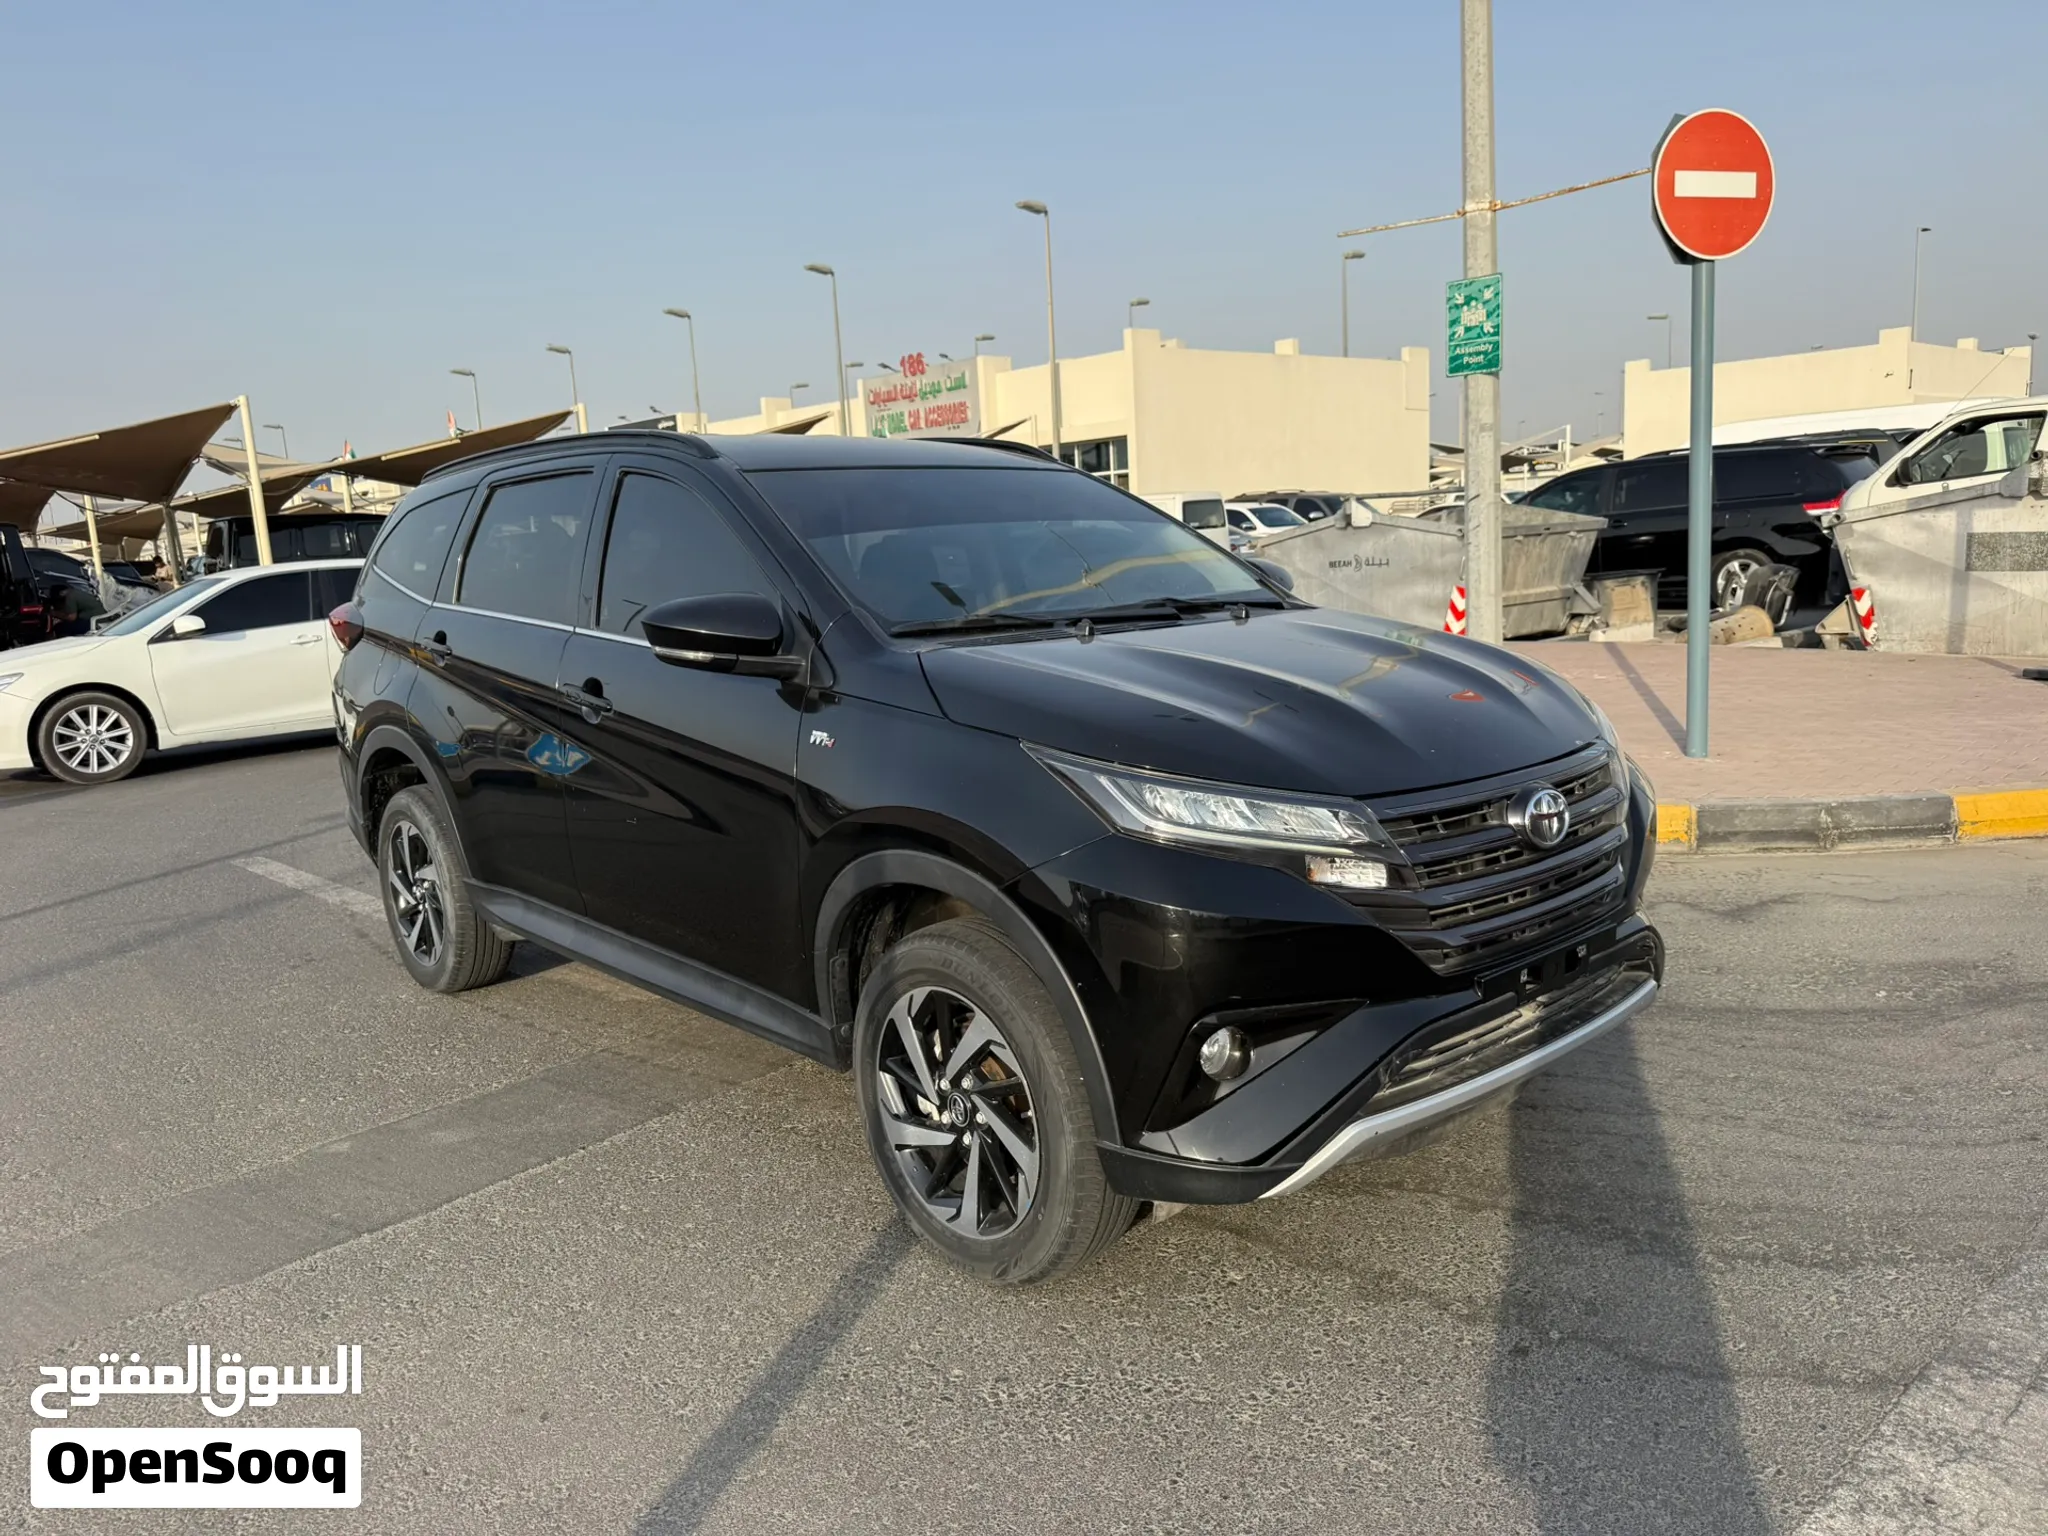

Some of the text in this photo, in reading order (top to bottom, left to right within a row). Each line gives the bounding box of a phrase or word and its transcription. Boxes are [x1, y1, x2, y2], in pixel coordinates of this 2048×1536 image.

[1455, 343, 1493, 355] Assembly
[899, 352, 926, 377] 186
[1463, 355, 1484, 365] Point
[1328, 560, 1352, 569] BEEAH
[940, 957, 1016, 1021] DUNLOP
